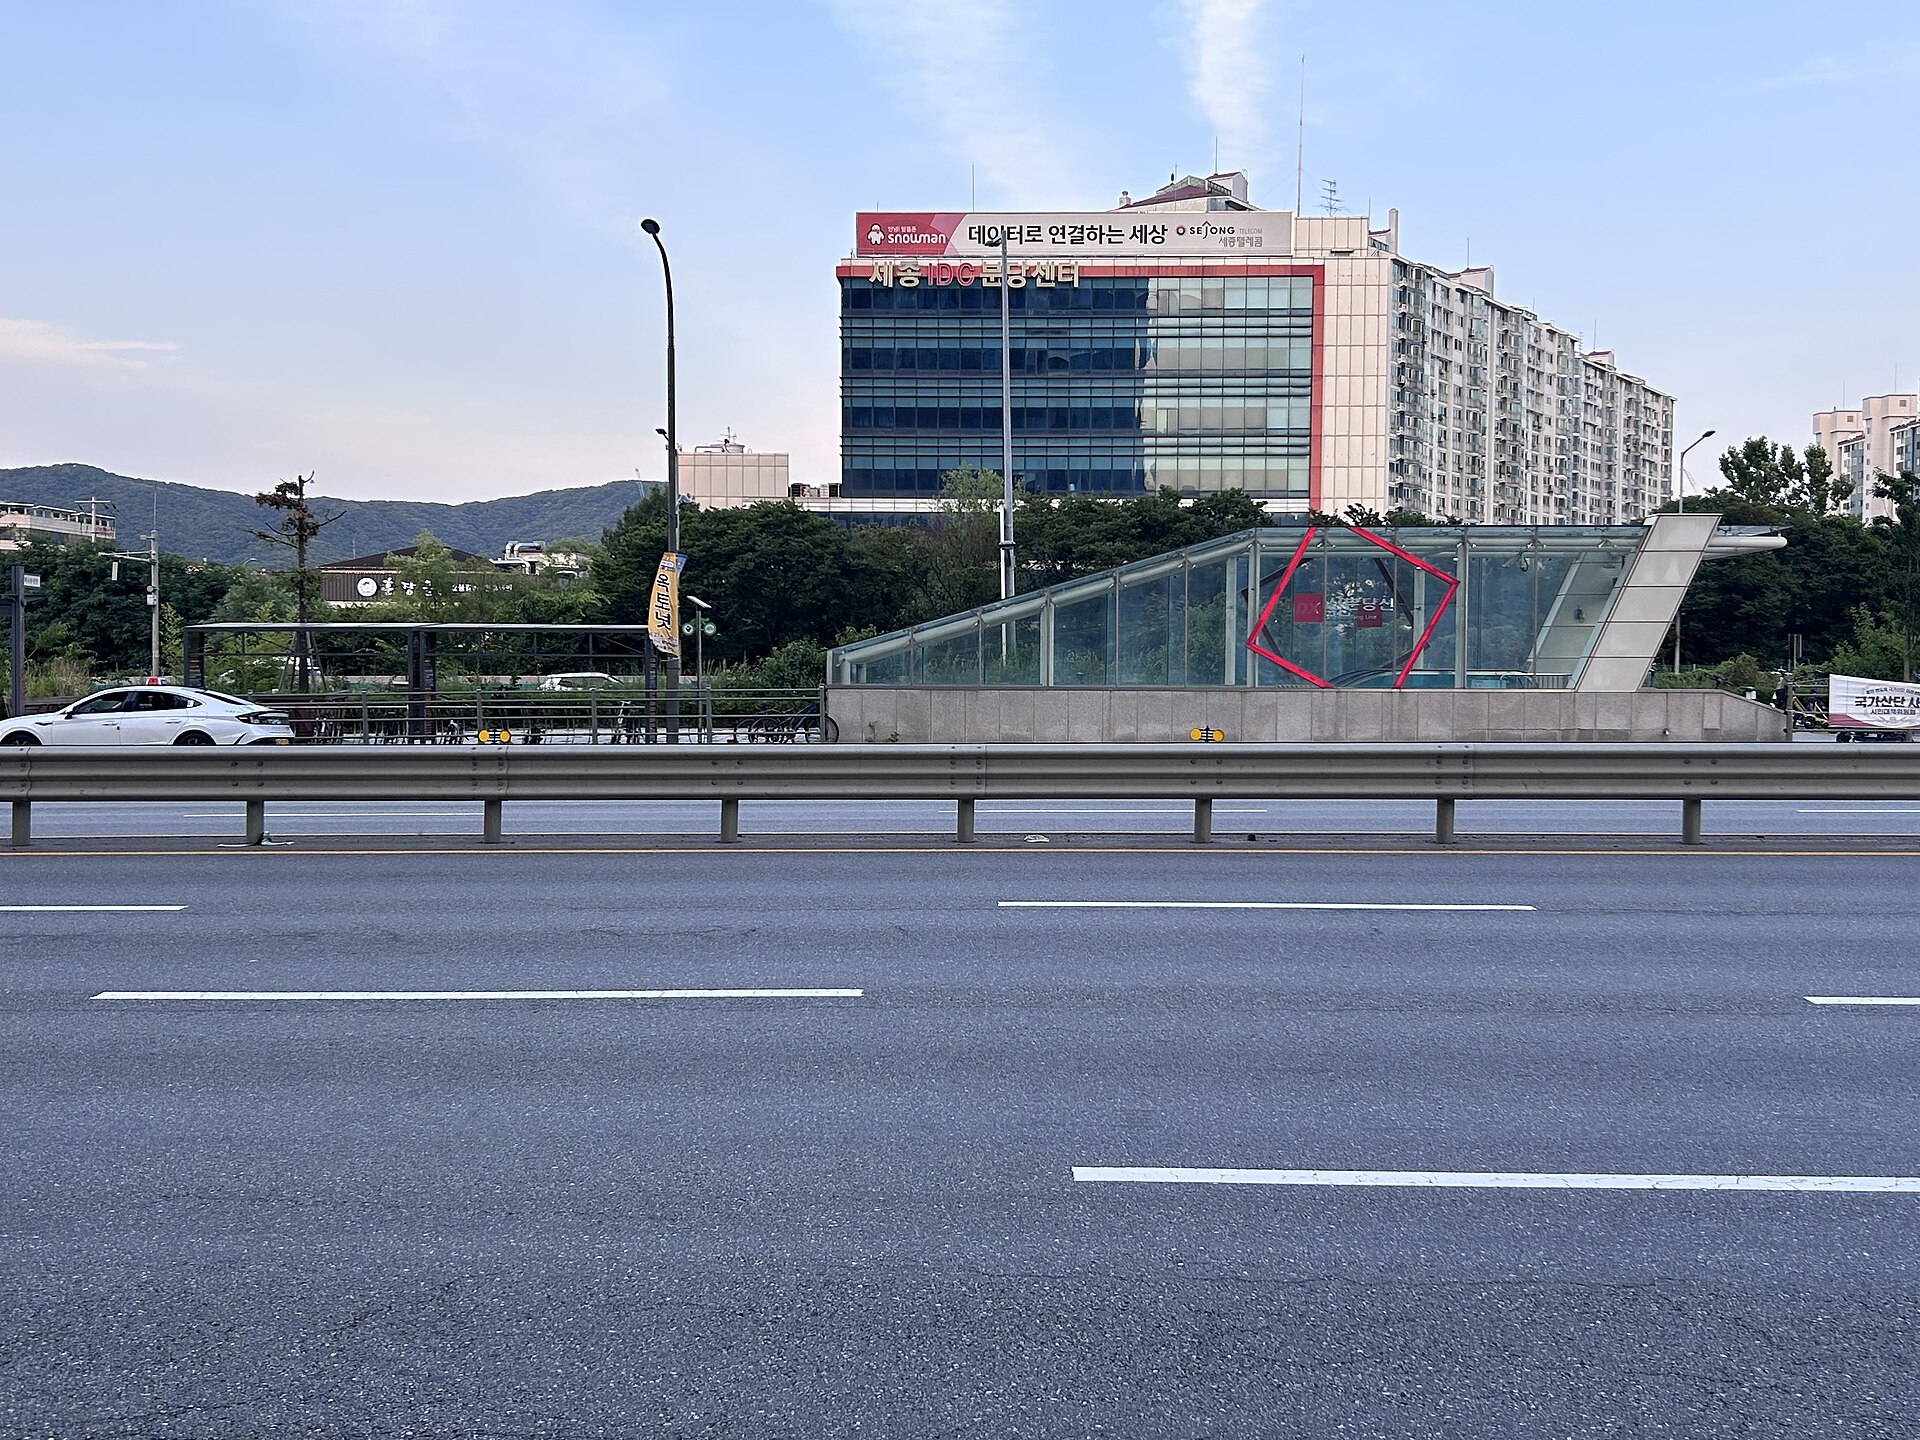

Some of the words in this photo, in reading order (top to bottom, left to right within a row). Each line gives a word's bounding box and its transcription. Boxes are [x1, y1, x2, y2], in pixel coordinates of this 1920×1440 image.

[968, 225, 1043, 245] 데이터로
[1048, 225, 1125, 245] 연결하는
[1129, 225, 1168, 244] 세상
[1189, 221, 1235, 239] SEJONG
[888, 233, 946, 244] snowman
[1219, 236, 1263, 248] 세종텔레콤
[1855, 695, 1905, 708] 국가산단
